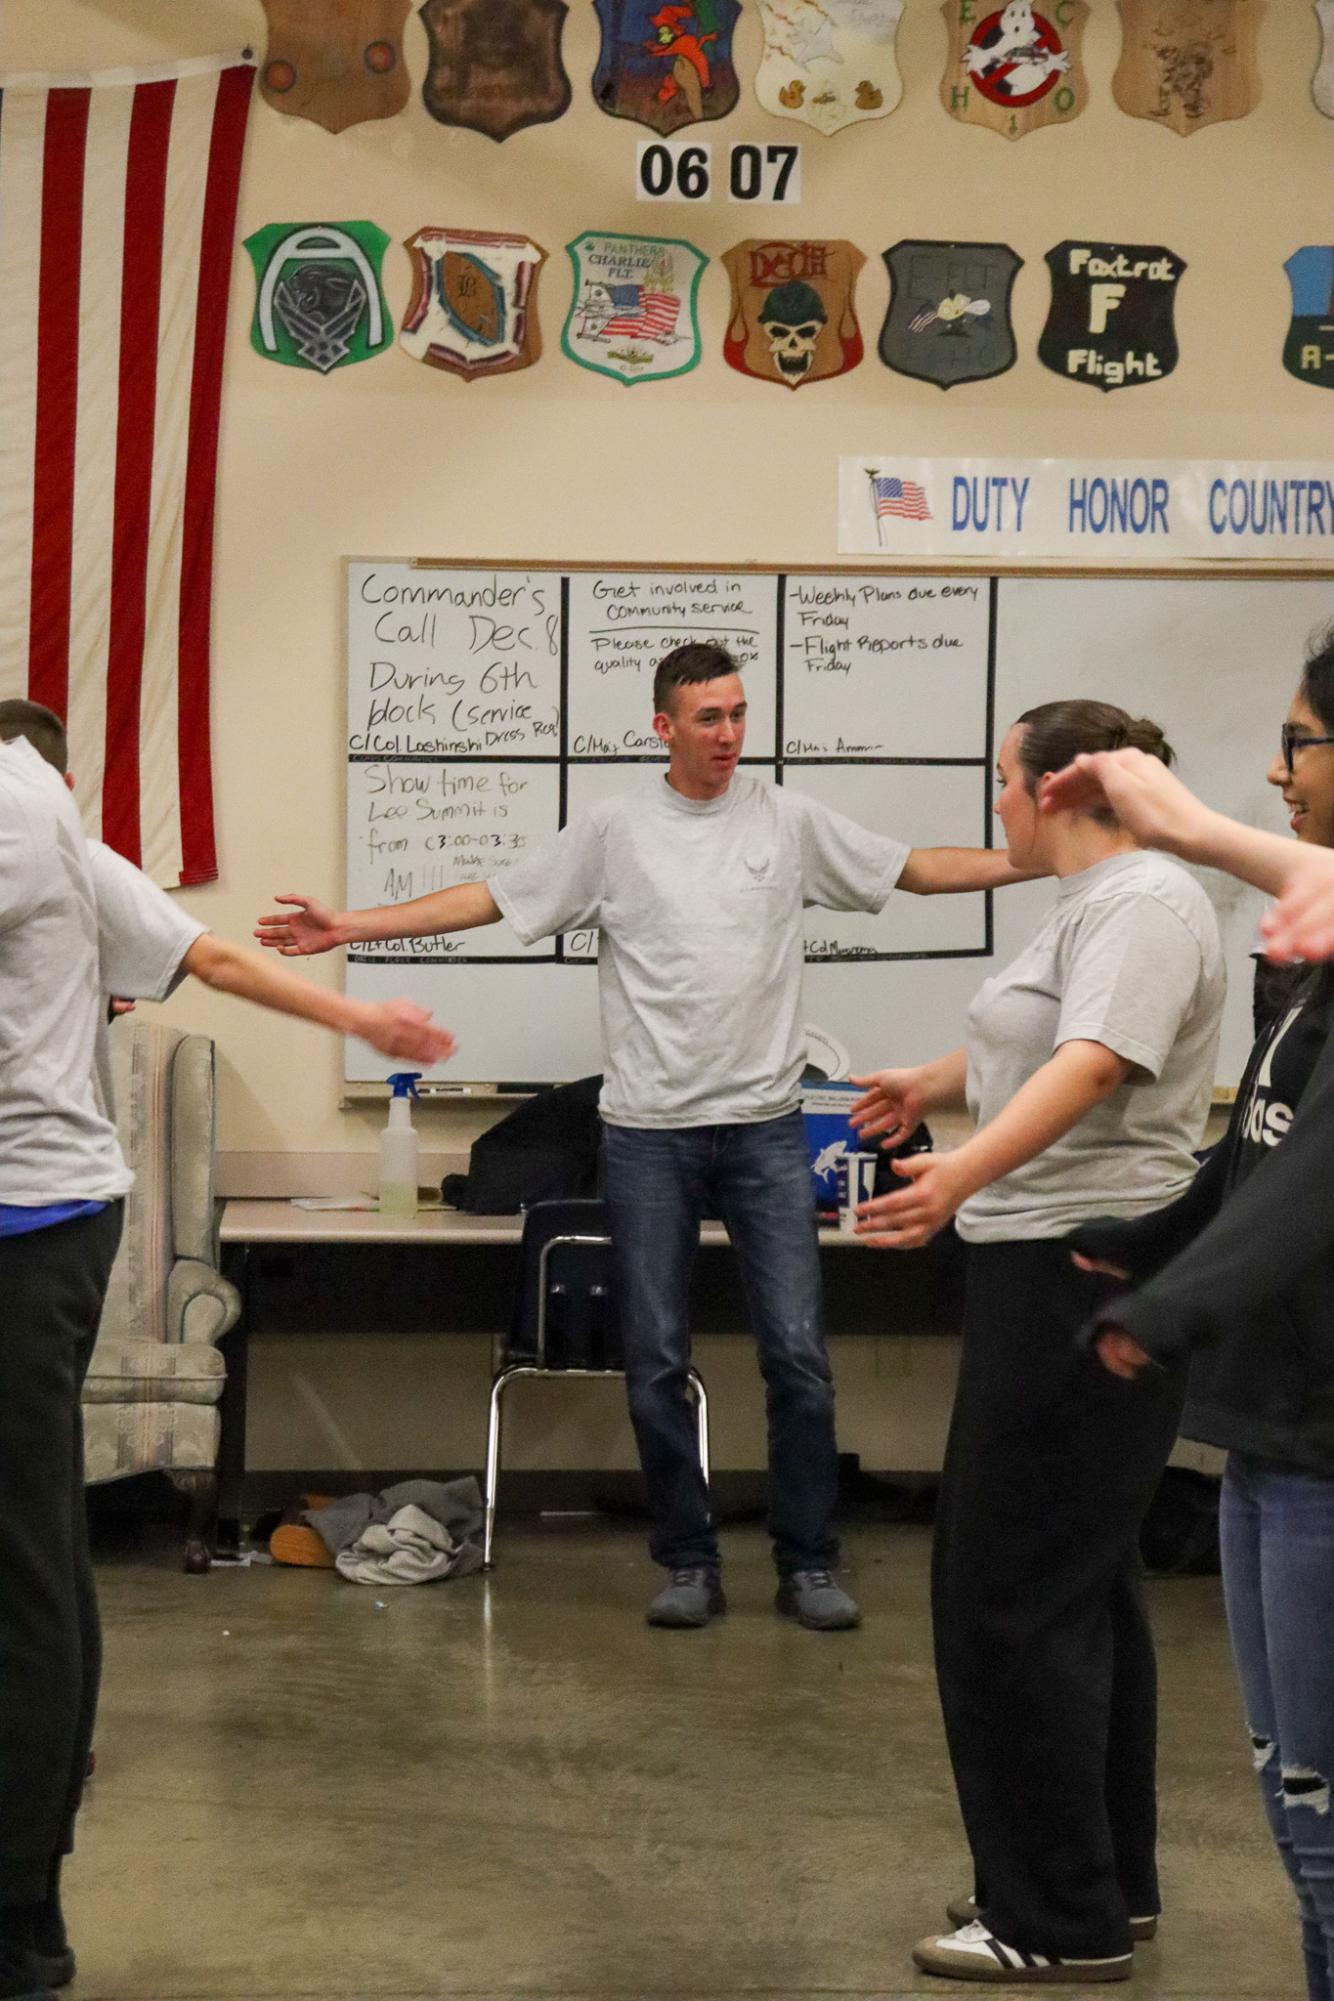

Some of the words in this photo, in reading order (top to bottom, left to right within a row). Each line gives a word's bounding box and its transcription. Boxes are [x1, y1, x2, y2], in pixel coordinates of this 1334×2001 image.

[640, 144, 709, 199] 06
[730, 144, 799, 201] 07
[588, 254, 652, 269] CHARLIE
[1069, 248, 1176, 281] Foxtrot
[1089, 283, 1127, 335] F
[1067, 348, 1163, 385] Flight
[952, 475, 1030, 533] DUTY
[1068, 477, 1169, 536] HONOR
[361, 573, 545, 616] Commander's
[593, 579, 641, 600] Get
[650, 578, 718, 595] involved
[725, 580, 742, 593] in
[859, 584, 901, 604] Plans
[907, 586, 937, 600] due
[940, 586, 979, 602] every
[691, 600, 753, 614] service
[797, 610, 850, 630] Friday
[374, 611, 437, 649] Call
[546, 613, 559, 656] 8
[591, 637, 655, 651] Please
[735, 636, 759, 648] the
[857, 634, 928, 655] Reports
[931, 633, 965, 649] due
[594, 657, 642, 675] quality
[804, 657, 852, 675] Friday
[369, 661, 465, 696] During
[480, 661, 538, 694] 6th
[364, 764, 432, 795] Show
[437, 768, 493, 798] time
[499, 770, 529, 798] for
[416, 799, 487, 821] Summit
[492, 802, 509, 819] is
[383, 867, 414, 901] AM
[407, 935, 466, 954] Butler
